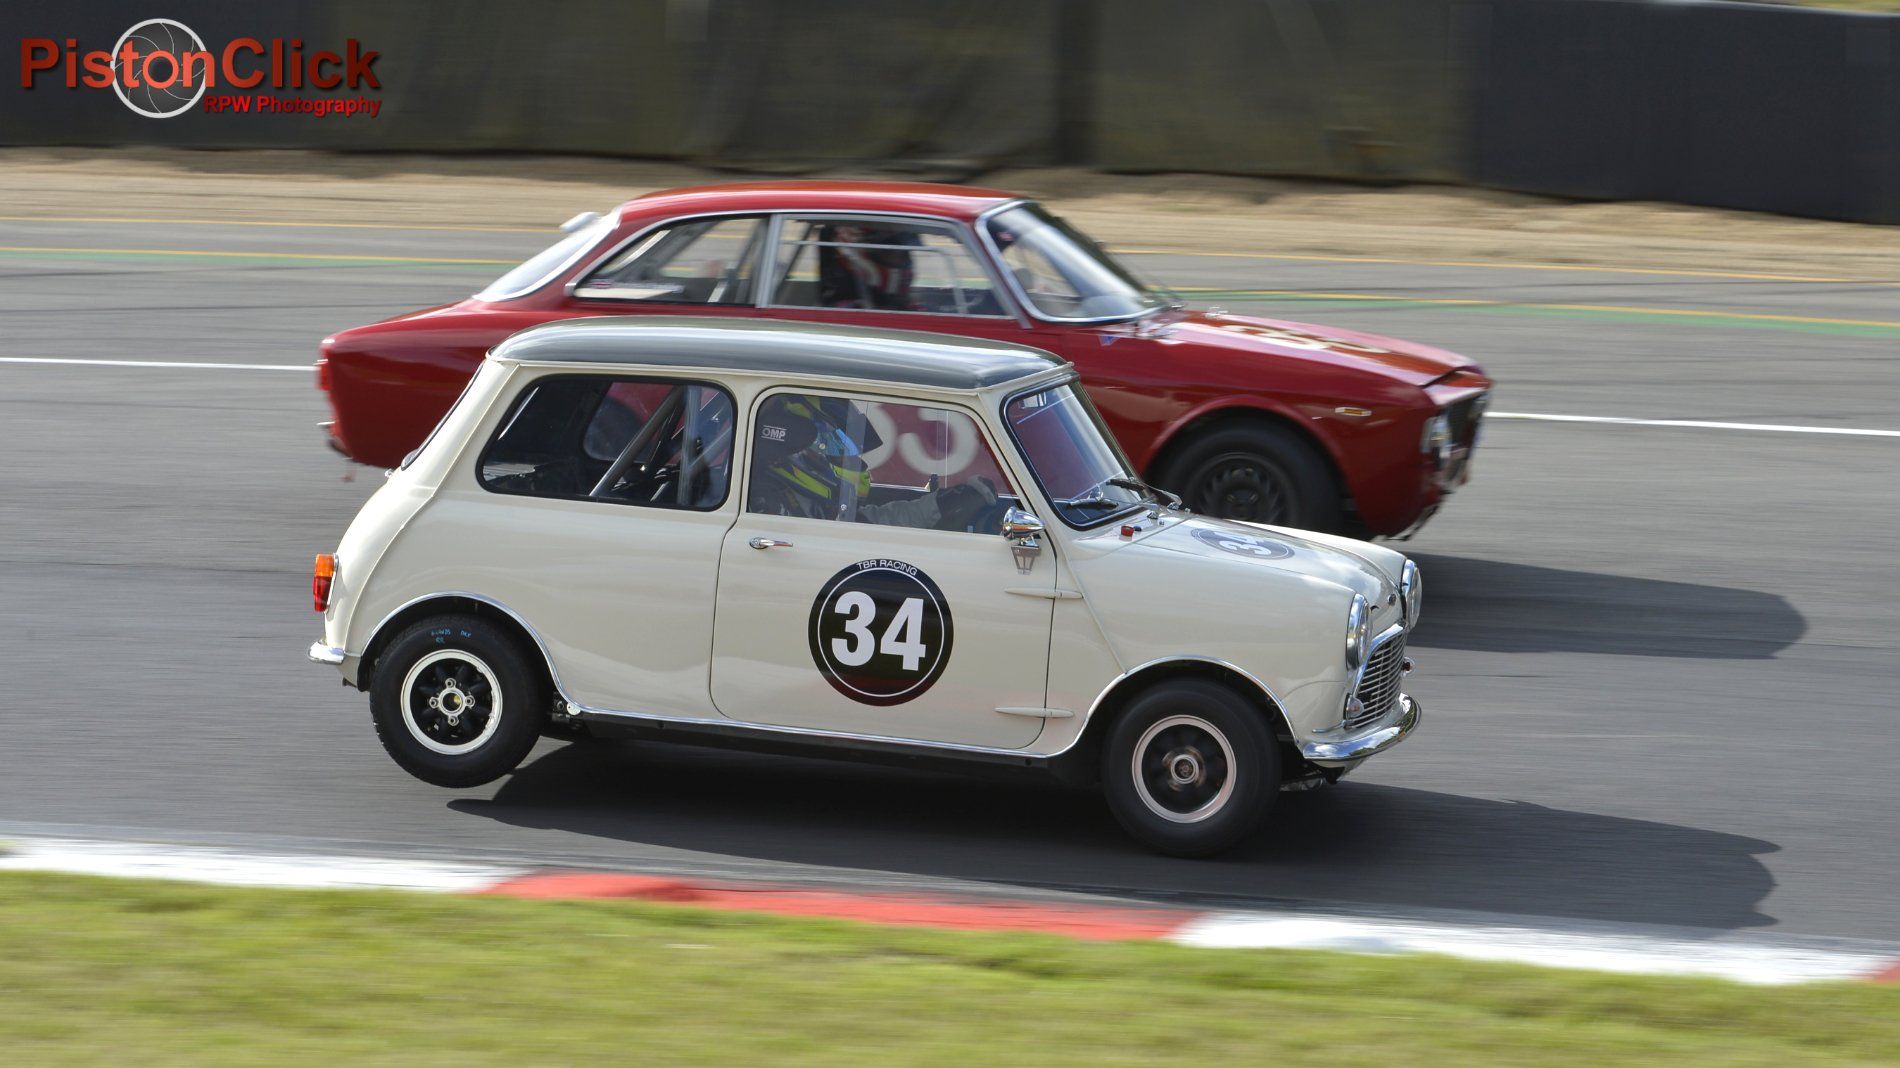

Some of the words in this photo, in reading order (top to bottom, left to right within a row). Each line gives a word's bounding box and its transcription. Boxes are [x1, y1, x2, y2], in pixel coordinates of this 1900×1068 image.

[761, 427, 786, 439] OMP
[856, 559, 877, 570] TBR
[879, 559, 918, 576] RACING
[831, 590, 926, 672] 34
